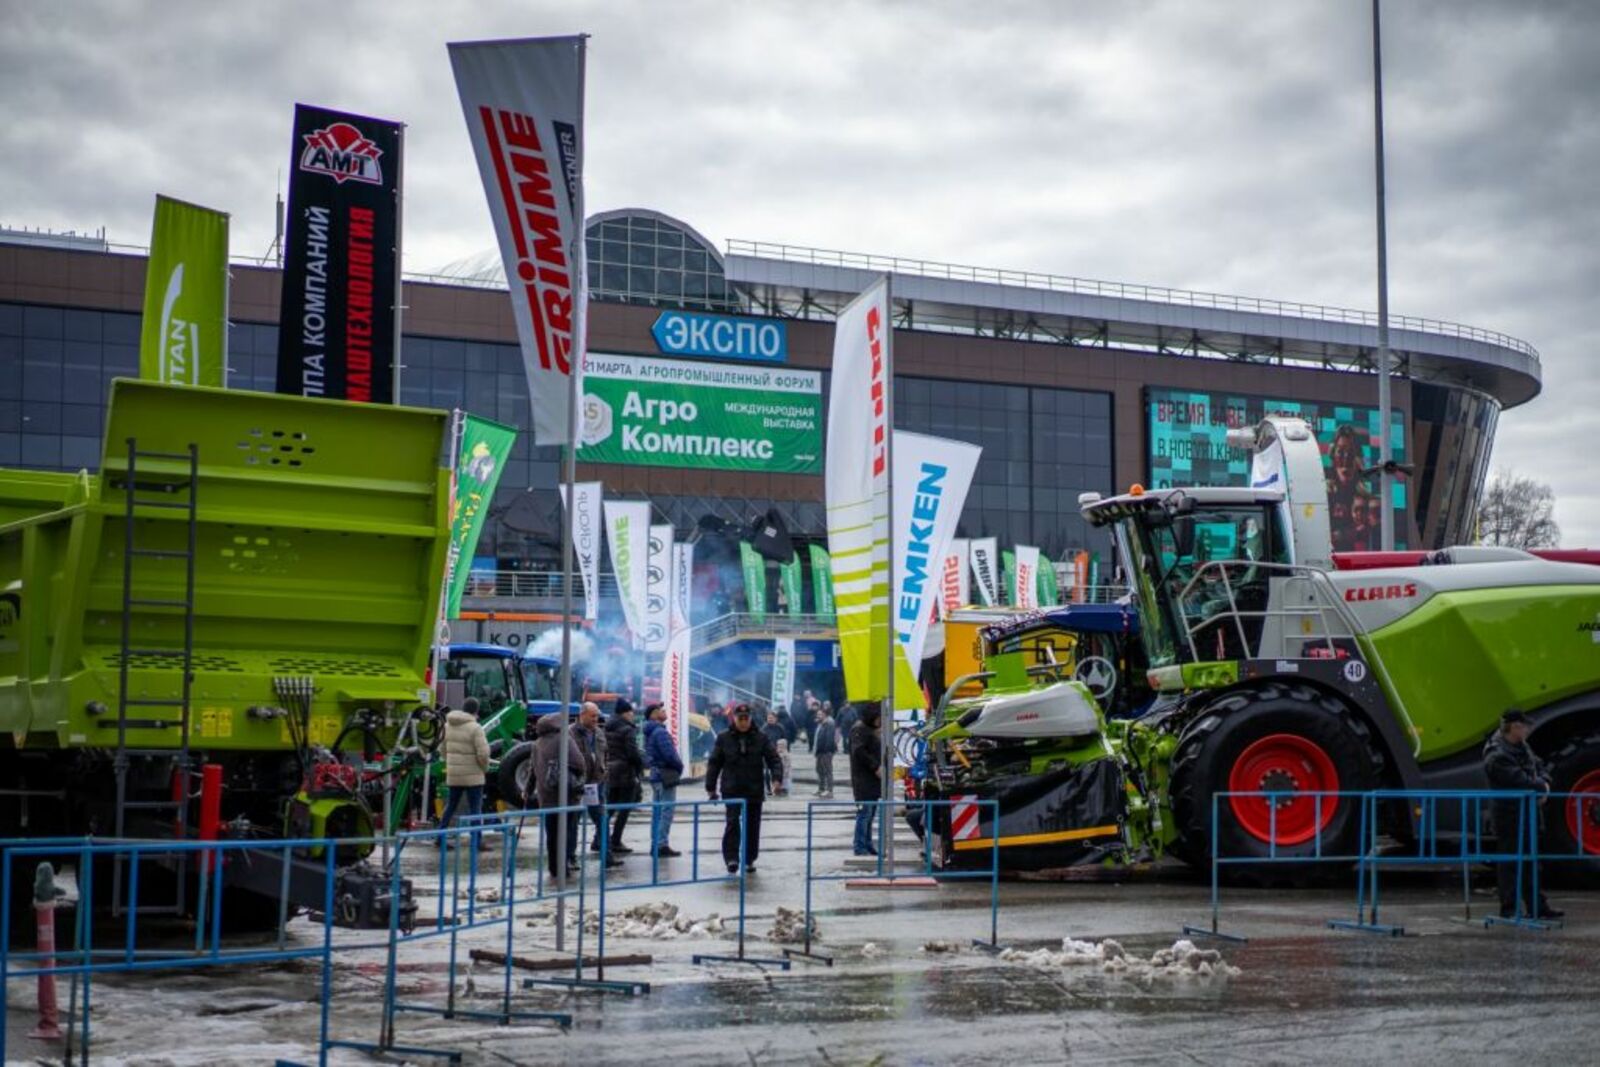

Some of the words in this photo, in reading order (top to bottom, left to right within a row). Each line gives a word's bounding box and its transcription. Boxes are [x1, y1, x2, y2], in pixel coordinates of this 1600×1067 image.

[303, 206, 331, 346] КОМПАНИЙ
[665, 316, 780, 357] ЭКСПО
[597, 362, 632, 375] МАРТА
[640, 364, 770, 387] АГРОПРОМЫШЛЕННЫЙ
[775, 376, 814, 389] ФОРУМ
[622, 391, 698, 425] Агро
[724, 402, 815, 417] МЕЖДУНАРОДНАЯ
[763, 417, 815, 430] ВЫСТАВКА
[622, 424, 774, 460] Комплекс
[1345, 583, 1416, 602] CLAAS
[1348, 664, 1362, 677] 40
